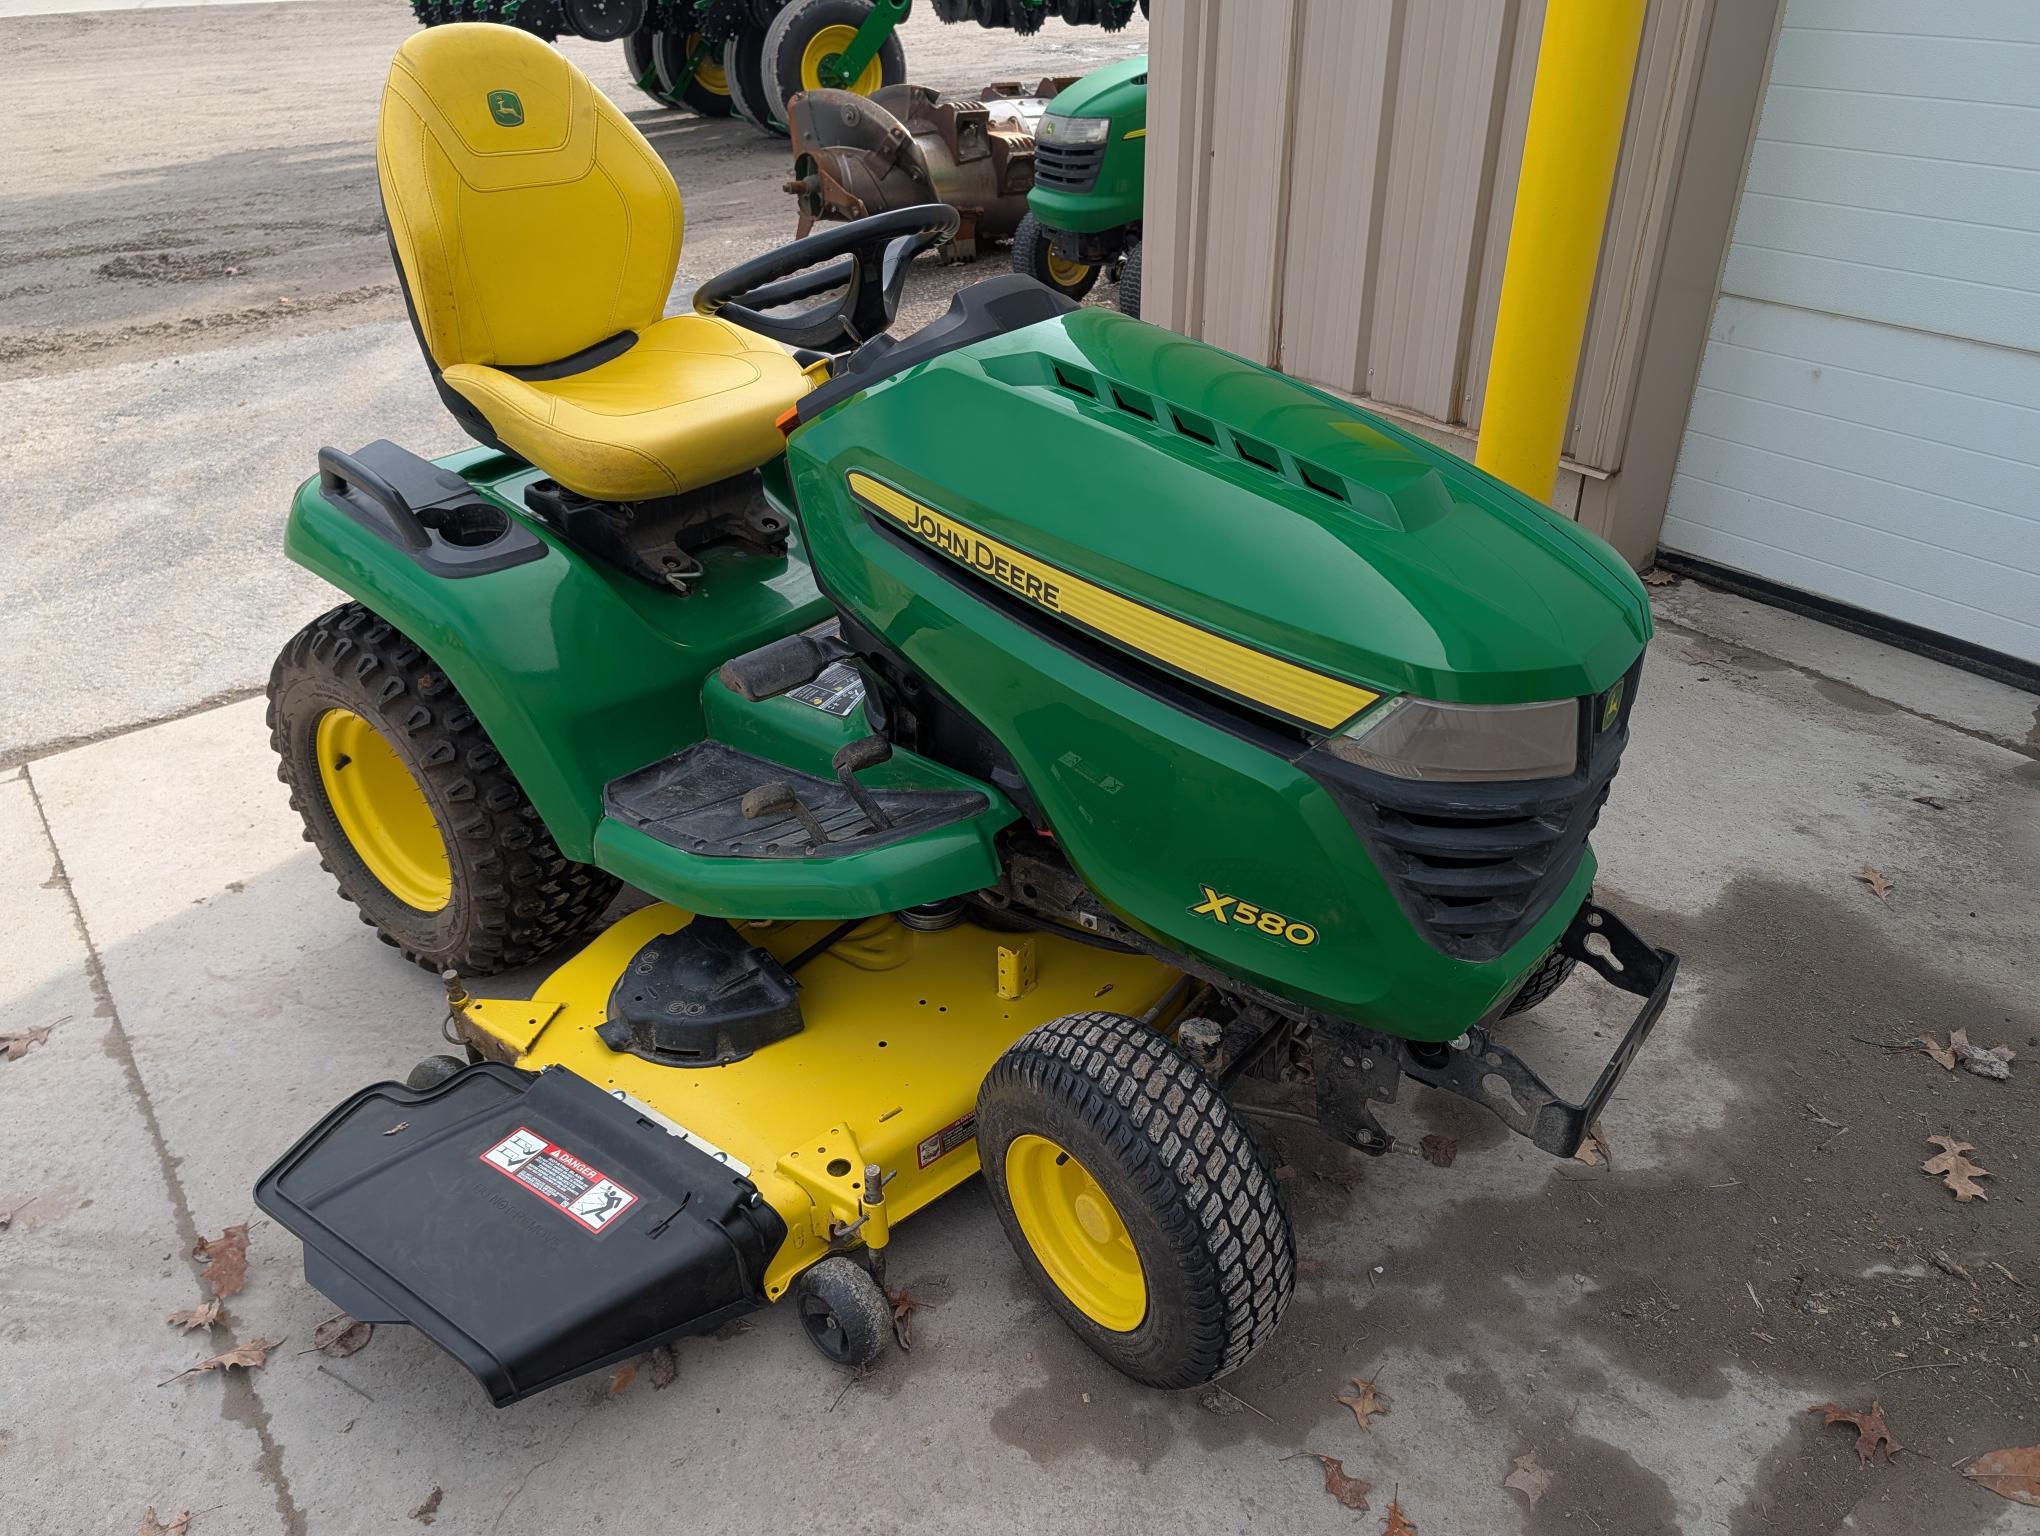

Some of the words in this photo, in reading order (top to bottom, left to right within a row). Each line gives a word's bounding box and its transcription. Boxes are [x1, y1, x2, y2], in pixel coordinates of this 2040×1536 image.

[907, 505, 969, 560] JOHN
[975, 540, 1060, 609] DEERE
[1191, 886, 1316, 946] X580
[559, 1153, 598, 1178] DANGER
